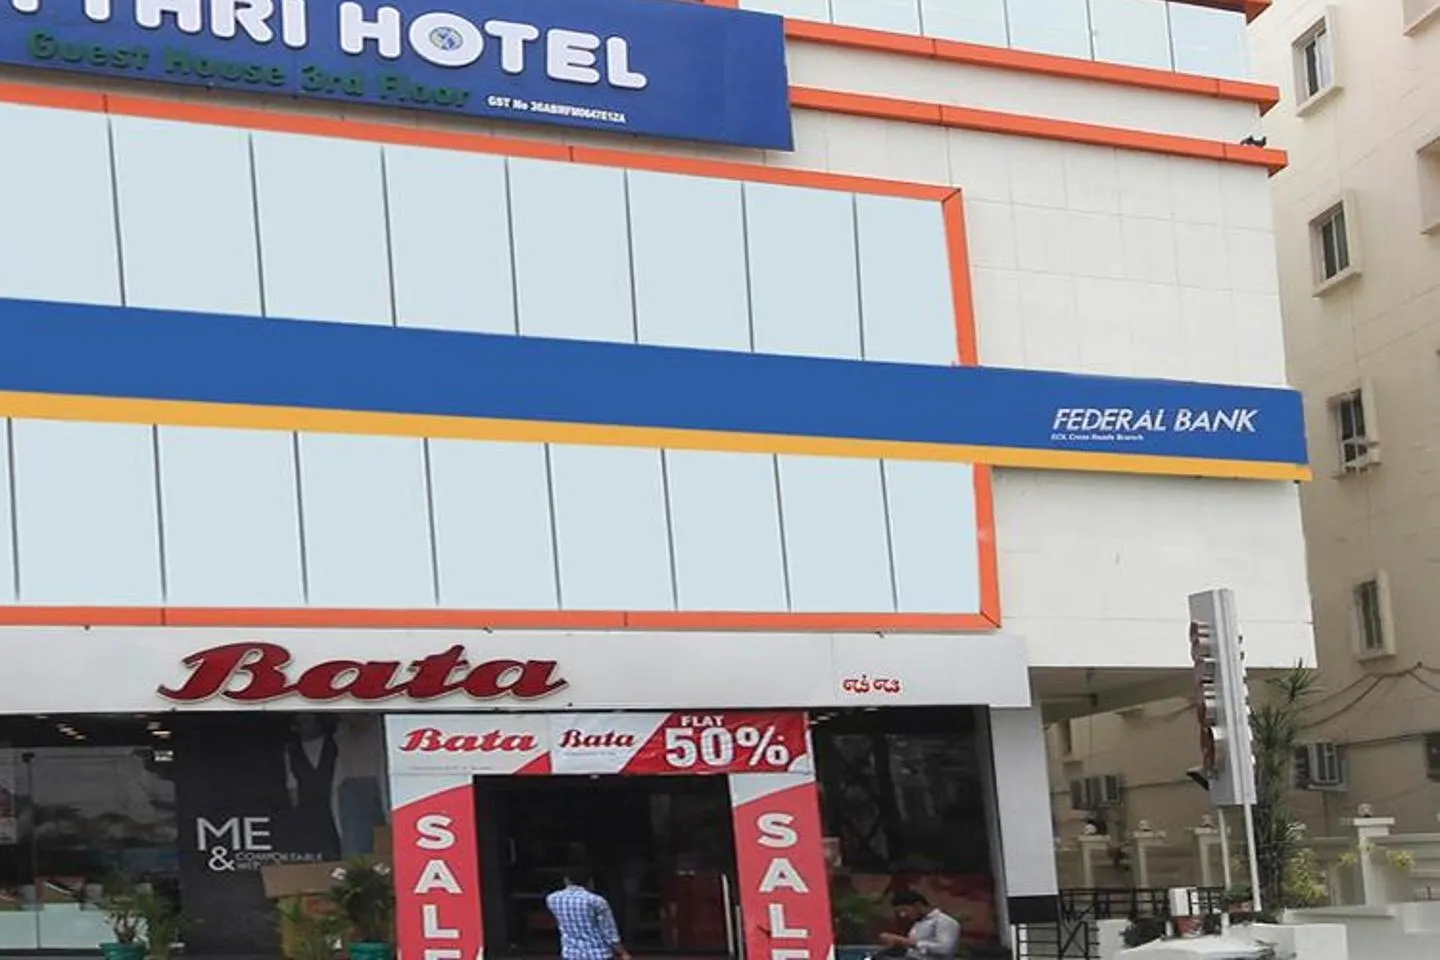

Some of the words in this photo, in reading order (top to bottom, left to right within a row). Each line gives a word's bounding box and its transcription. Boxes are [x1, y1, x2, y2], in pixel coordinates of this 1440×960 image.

[339, 1, 648, 90] HOTEL
[28, 26, 150, 71] Guest
[164, 43, 288, 87] House
[296, 63, 365, 97] 3rd
[378, 70, 472, 108] Floor
[487, 95, 511, 108] GST
[1052, 407, 1166, 432] FEDERAL
[1173, 408, 1259, 433] BANK
[156, 641, 570, 703] Bata
[680, 715, 725, 727] FLAT
[399, 726, 539, 753] Bata
[559, 728, 636, 748] Bata
[664, 725, 790, 769] 50%
[195, 816, 273, 852] ME
